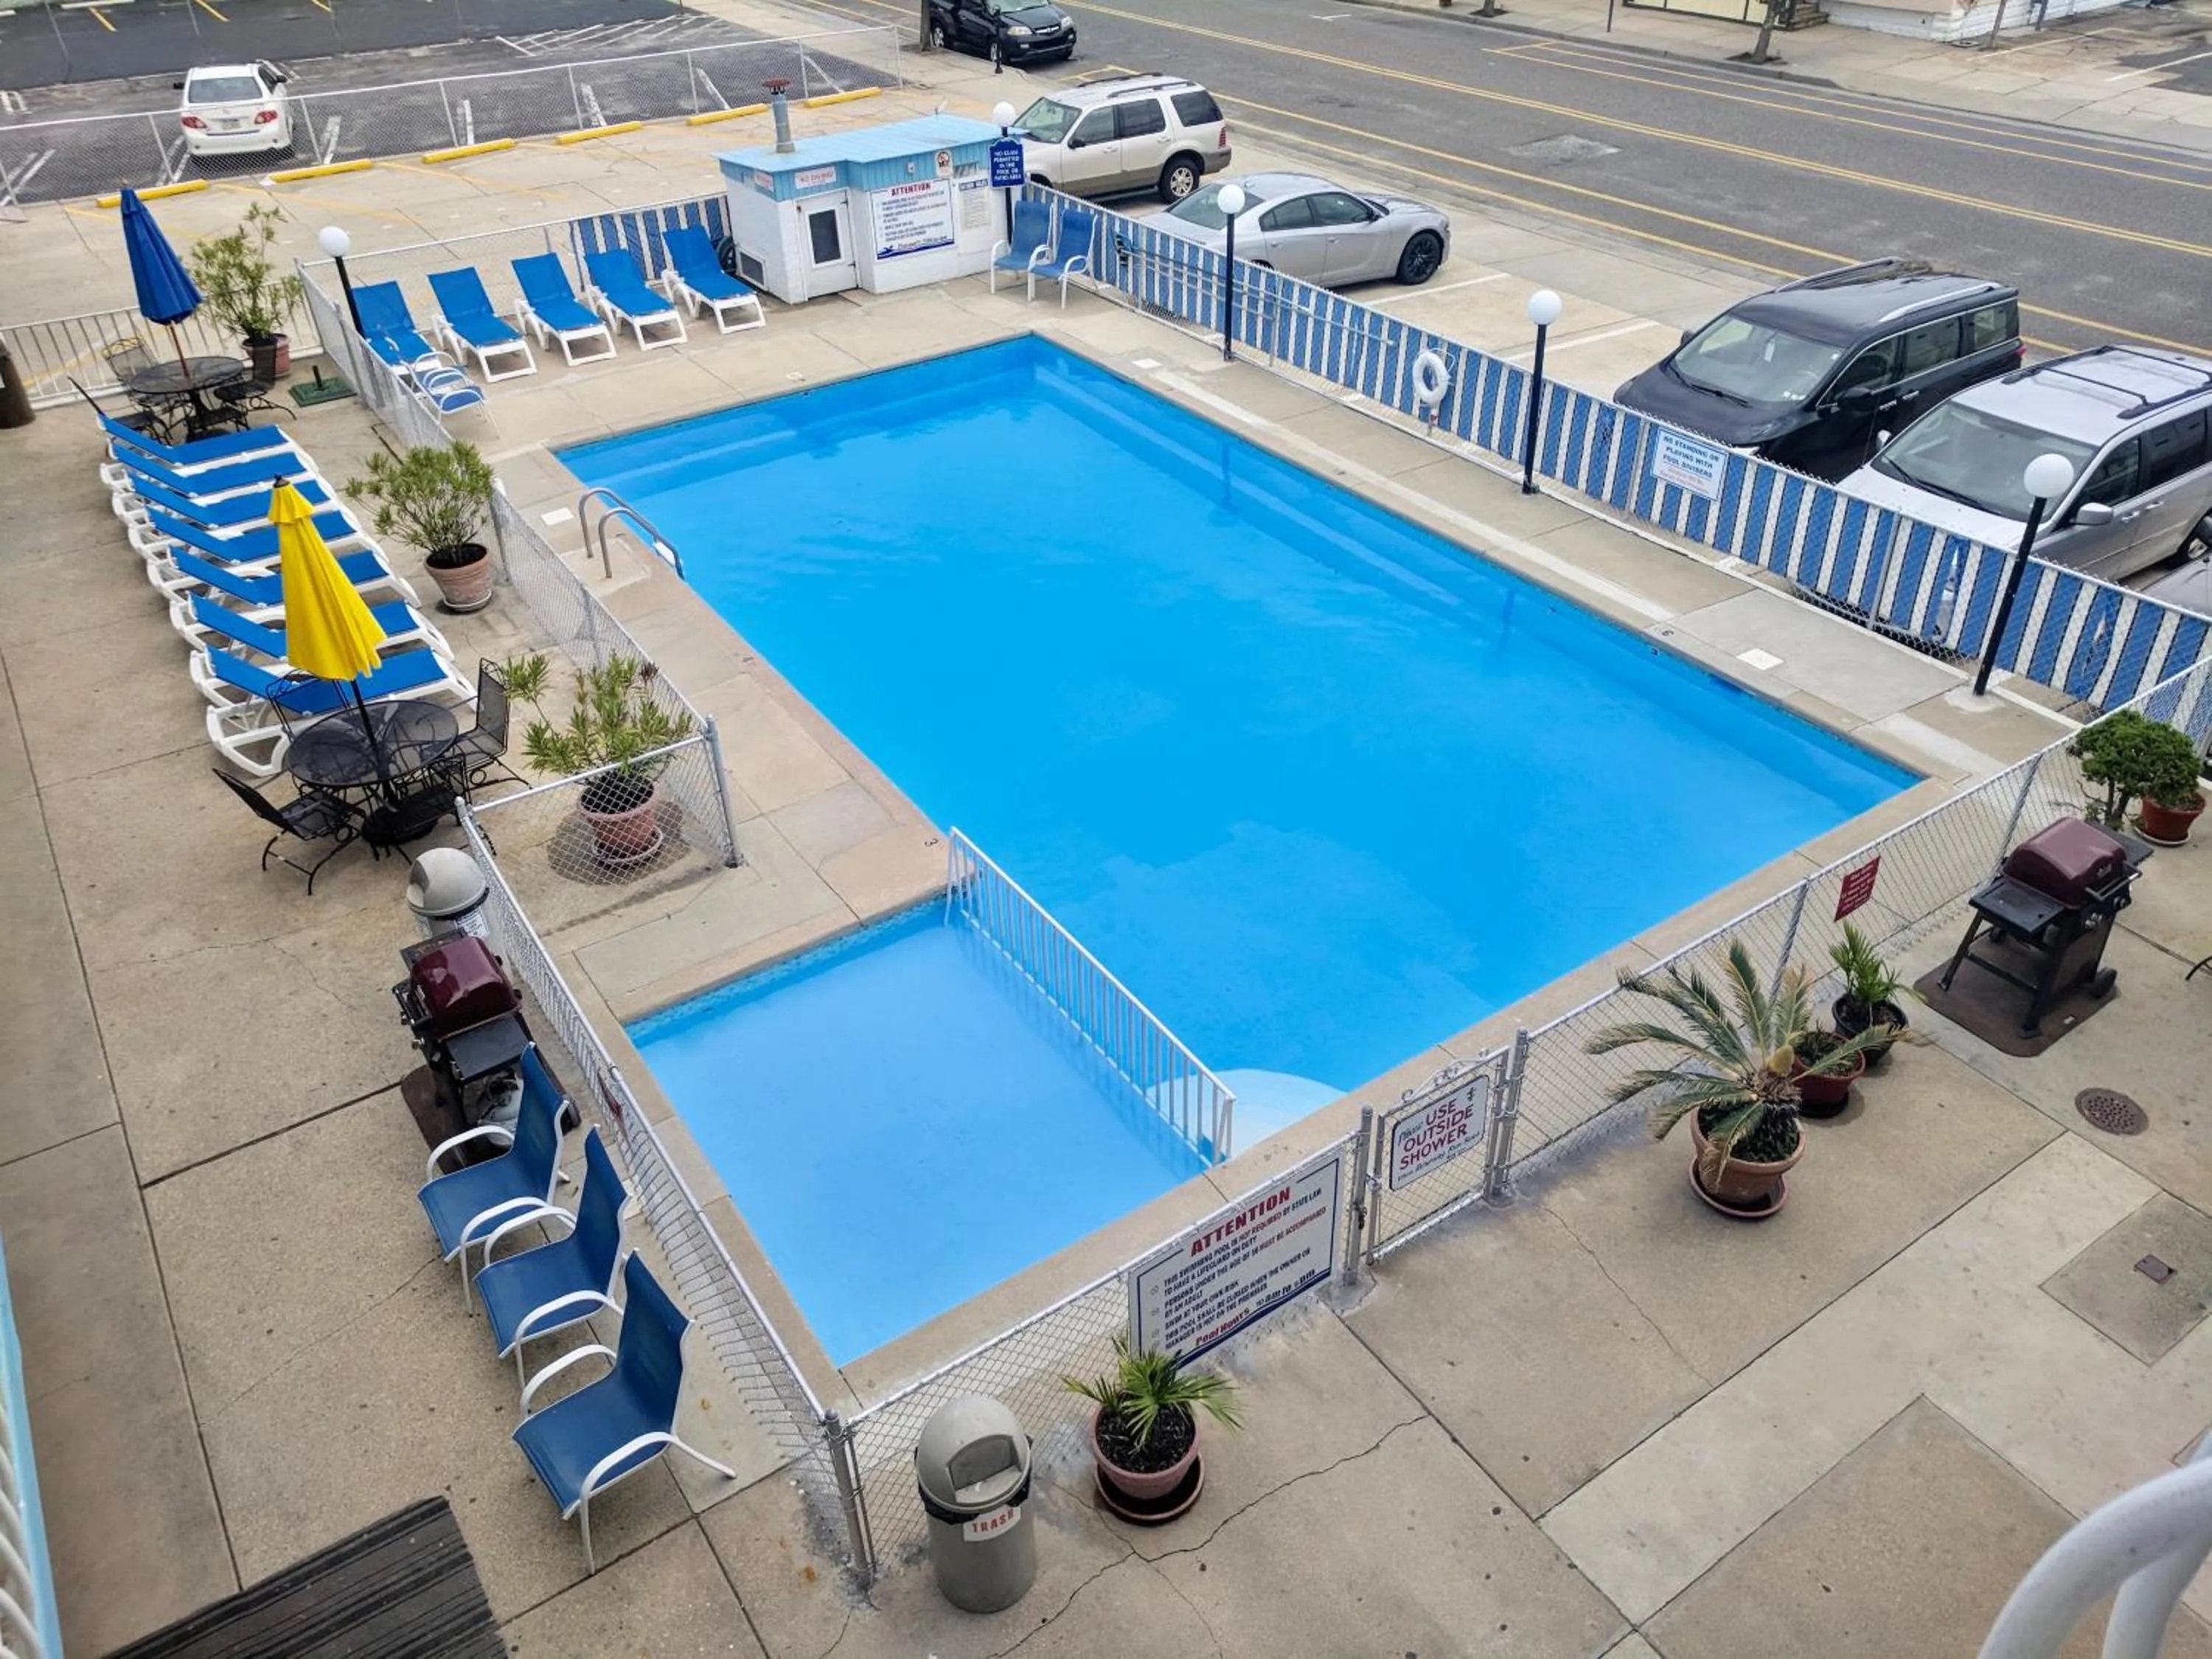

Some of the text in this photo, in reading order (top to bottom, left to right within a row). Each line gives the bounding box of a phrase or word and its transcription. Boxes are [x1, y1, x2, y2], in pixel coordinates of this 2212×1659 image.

[891, 182, 931, 196] ATTENTION
[1663, 454, 1678, 465] POOL
[1666, 447, 1712, 467] PLAYING WITH
[1675, 440, 1706, 456] STANDING
[1404, 1105, 1472, 1152] OUTSIDE
[1426, 1099, 1456, 1125] USE
[1401, 1124, 1467, 1169] SHOWER
[1180, 1253, 1212, 1277] SWIMMING
[1214, 1243, 1229, 1256] POOL
[1231, 1238, 1237, 1246] IS
[1292, 1196, 1307, 1211] STATE
[1310, 1189, 1321, 1200] LAW
[1191, 1186, 1290, 1257] ATTENTION
[1164, 1287, 1172, 1295] TO
[1174, 1276, 1189, 1291] HAVE
[1197, 1252, 1230, 1277] LIFEGUARD
[1231, 1247, 1239, 1256] ON
[1242, 1236, 1256, 1250] DUTY
[1165, 1286, 1193, 1308] PERSONS
[1195, 1273, 1215, 1290] UNDER
[1217, 1265, 1227, 1276] THE
[1230, 1257, 1240, 1268] AGE
[1242, 1252, 1249, 1261] OF
[1259, 1237, 1275, 1250] MUST
[1286, 1207, 1326, 1234] ACCOMPANIED
[1165, 1290, 1202, 1318] BY AN ADULT
[1166, 1329, 1178, 1340] THIS
[1180, 1318, 1195, 1332] POOL
[1197, 1307, 1215, 1321] SHALL
[1217, 1299, 1224, 1309] BE
[1226, 1285, 1248, 1303] CLOSED
[1251, 1274, 1267, 1288] WHEN
[1269, 1267, 1278, 1276] THE
[1280, 1253, 1301, 1270] OWNER
[1166, 1281, 1239, 1329] SWIM AT YOUR OWN RISK
[1166, 1327, 1194, 1349] MANAGER
[1203, 1314, 1214, 1326] NOT
[1217, 1310, 1224, 1318] ON
[1226, 1301, 1236, 1312] THE
[1238, 1283, 1267, 1304] PREMISES
[972, 1507, 1015, 1534] TRASH
